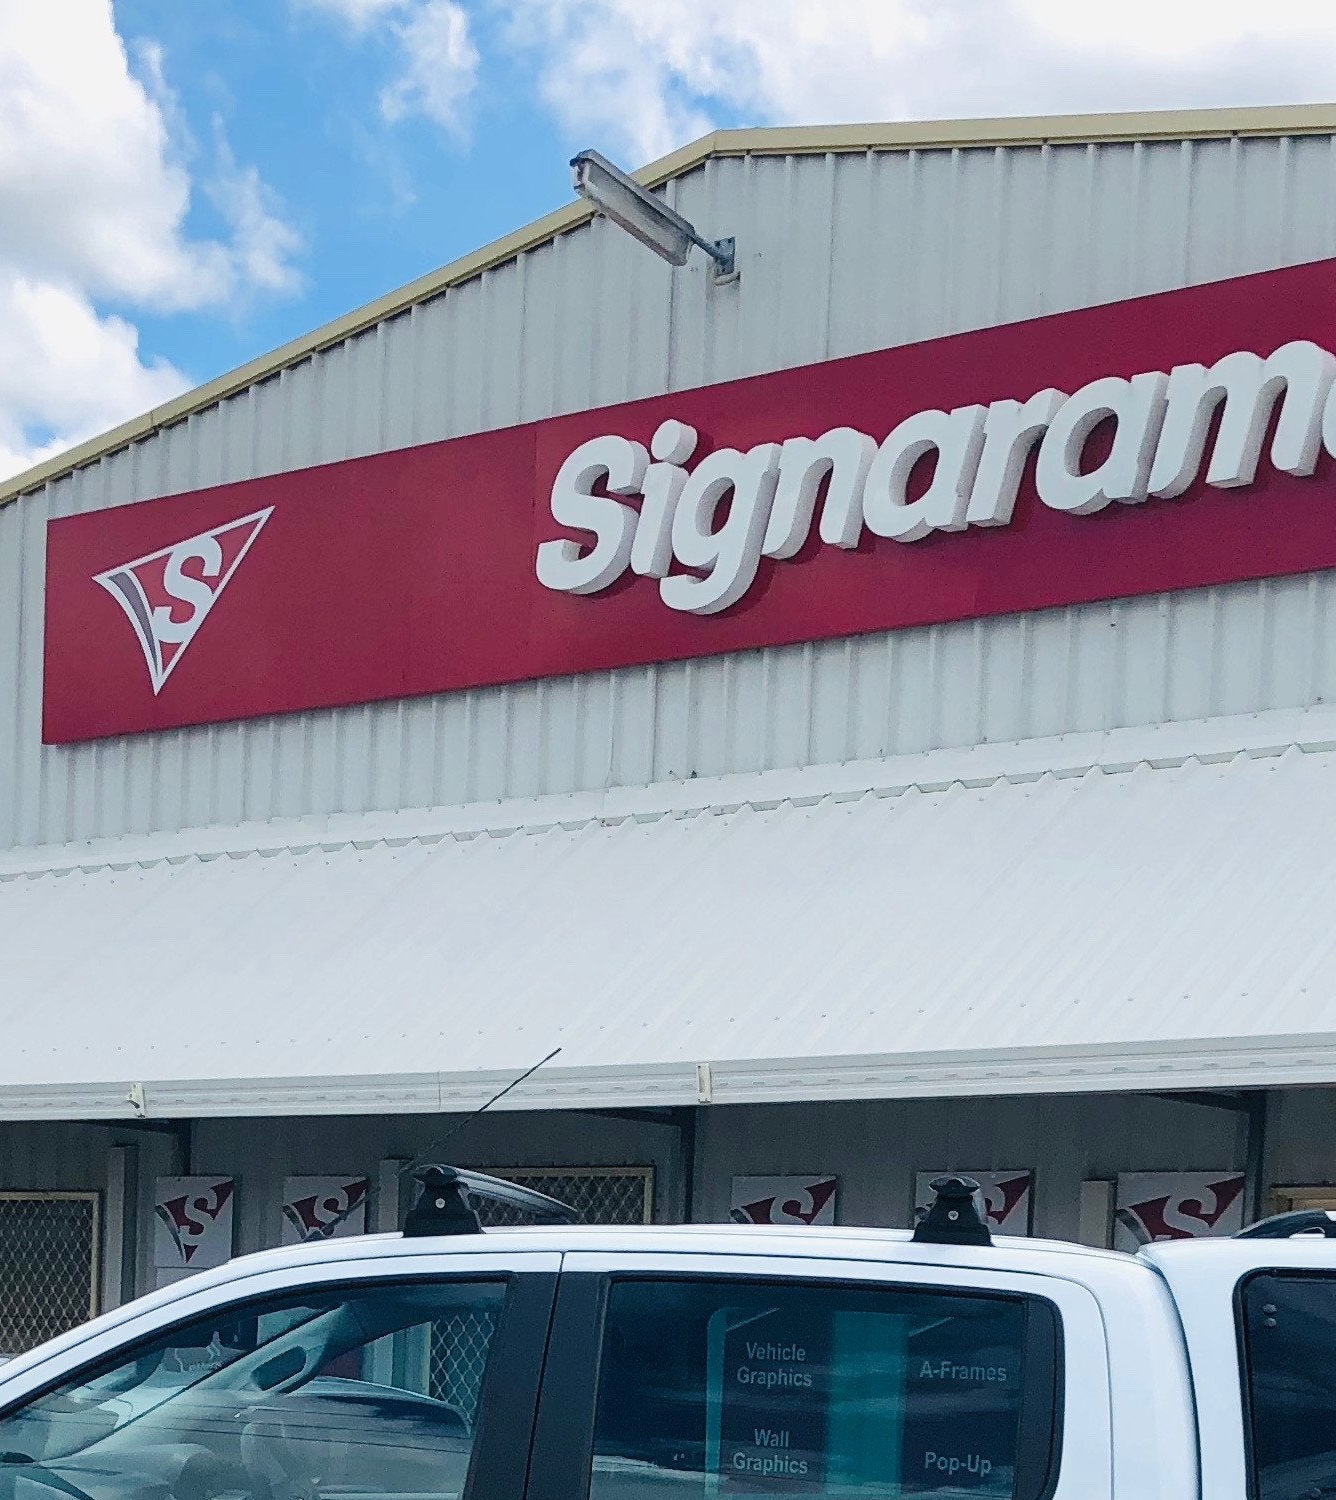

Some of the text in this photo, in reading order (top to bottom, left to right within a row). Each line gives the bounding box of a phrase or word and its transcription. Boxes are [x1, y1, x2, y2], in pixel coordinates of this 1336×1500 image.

[746, 1342, 806, 1362] Vehicle
[737, 1366, 813, 1389] Graphics
[919, 1360, 1007, 1382] A-Frames
[754, 1428, 790, 1447] Wall
[733, 1451, 809, 1475] Graphics
[924, 1451, 993, 1477] Pop-Up
